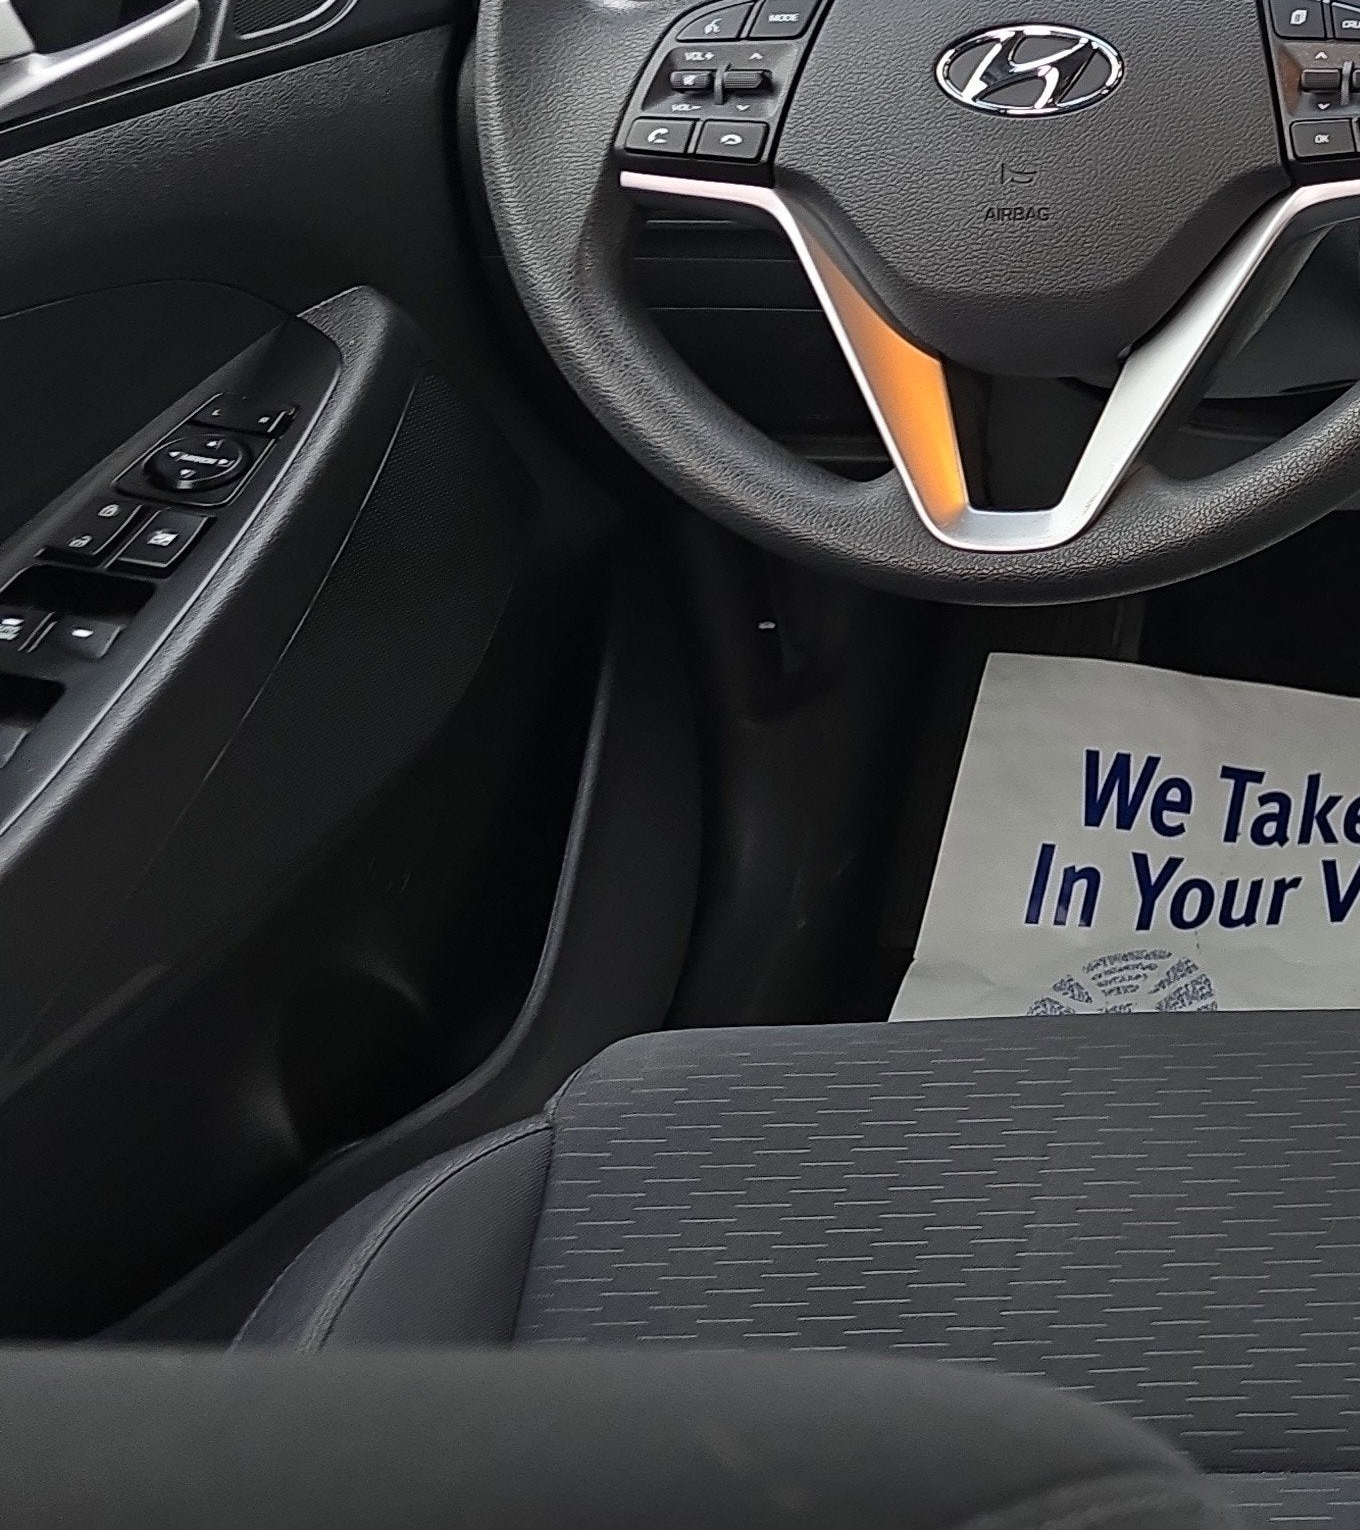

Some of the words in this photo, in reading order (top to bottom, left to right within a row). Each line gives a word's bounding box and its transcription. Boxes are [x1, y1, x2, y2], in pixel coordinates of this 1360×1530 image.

[769, 13, 800, 22] MODE
[1315, 133, 1330, 144] OK
[984, 206, 1051, 222] AIRBAG
[1083, 748, 1193, 838] We
[1025, 842, 1102, 928] In
[1131, 851, 1303, 932] Your
